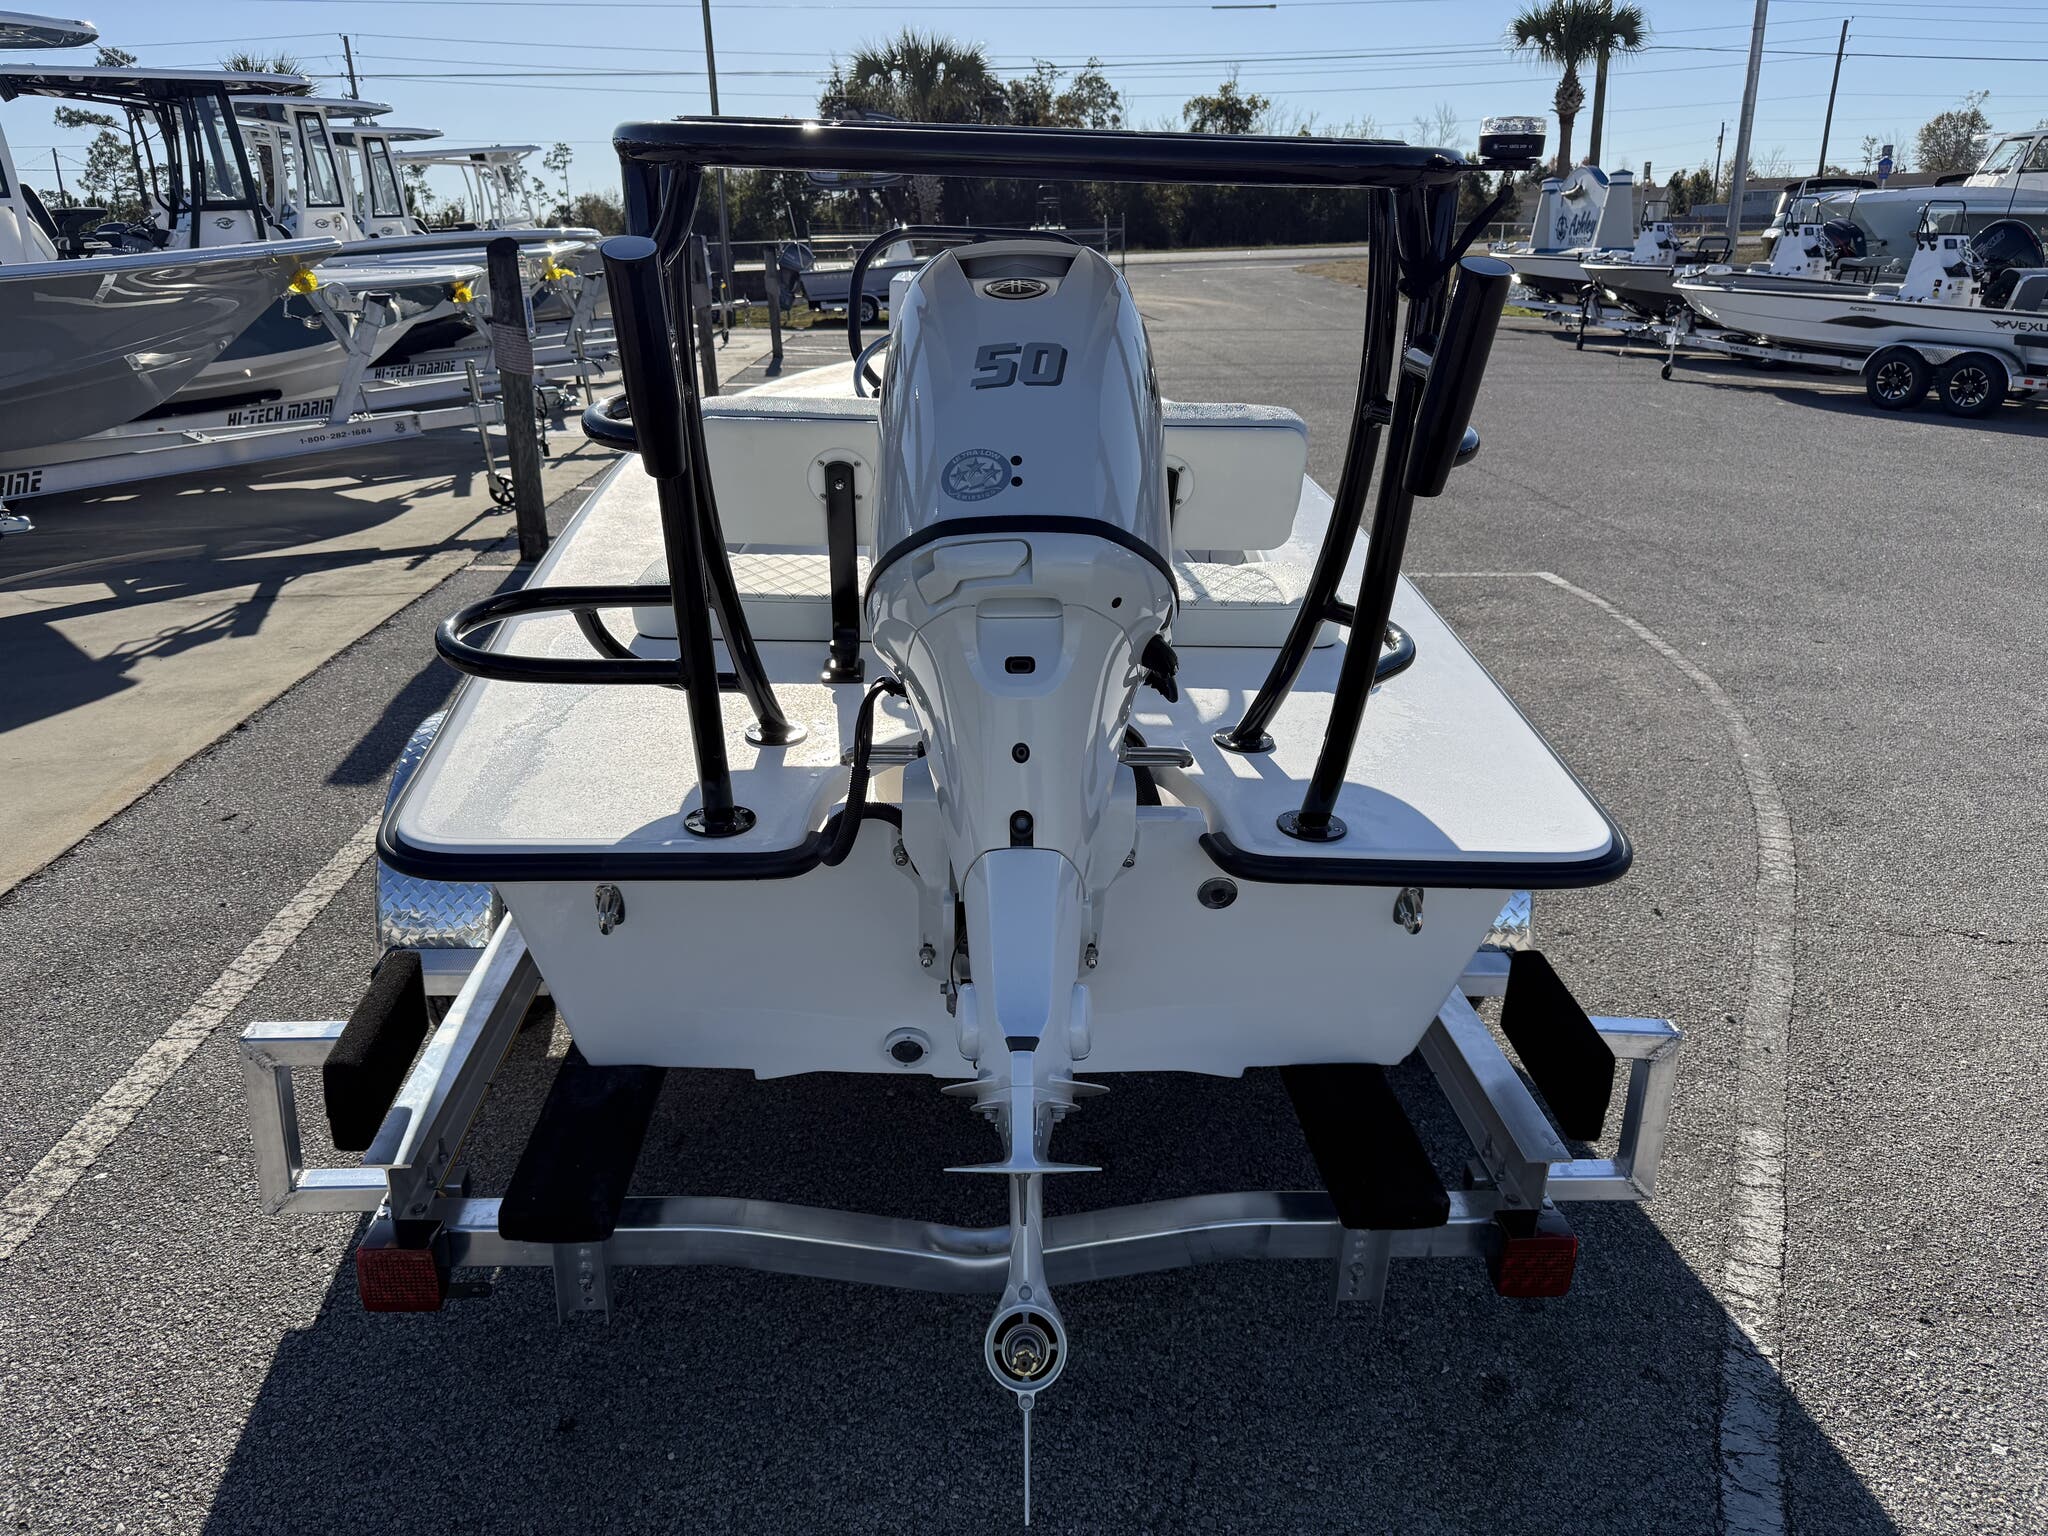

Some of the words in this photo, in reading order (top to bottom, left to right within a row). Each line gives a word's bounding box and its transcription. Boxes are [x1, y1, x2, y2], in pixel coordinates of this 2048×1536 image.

[1569, 210, 1597, 242] Ashley
[374, 364, 415, 379] HI-TECH
[416, 360, 456, 376] MARINE
[970, 342, 1069, 390] 50
[227, 405, 283, 426] HI-TECH
[300, 427, 372, 444] 1-800-282-1684
